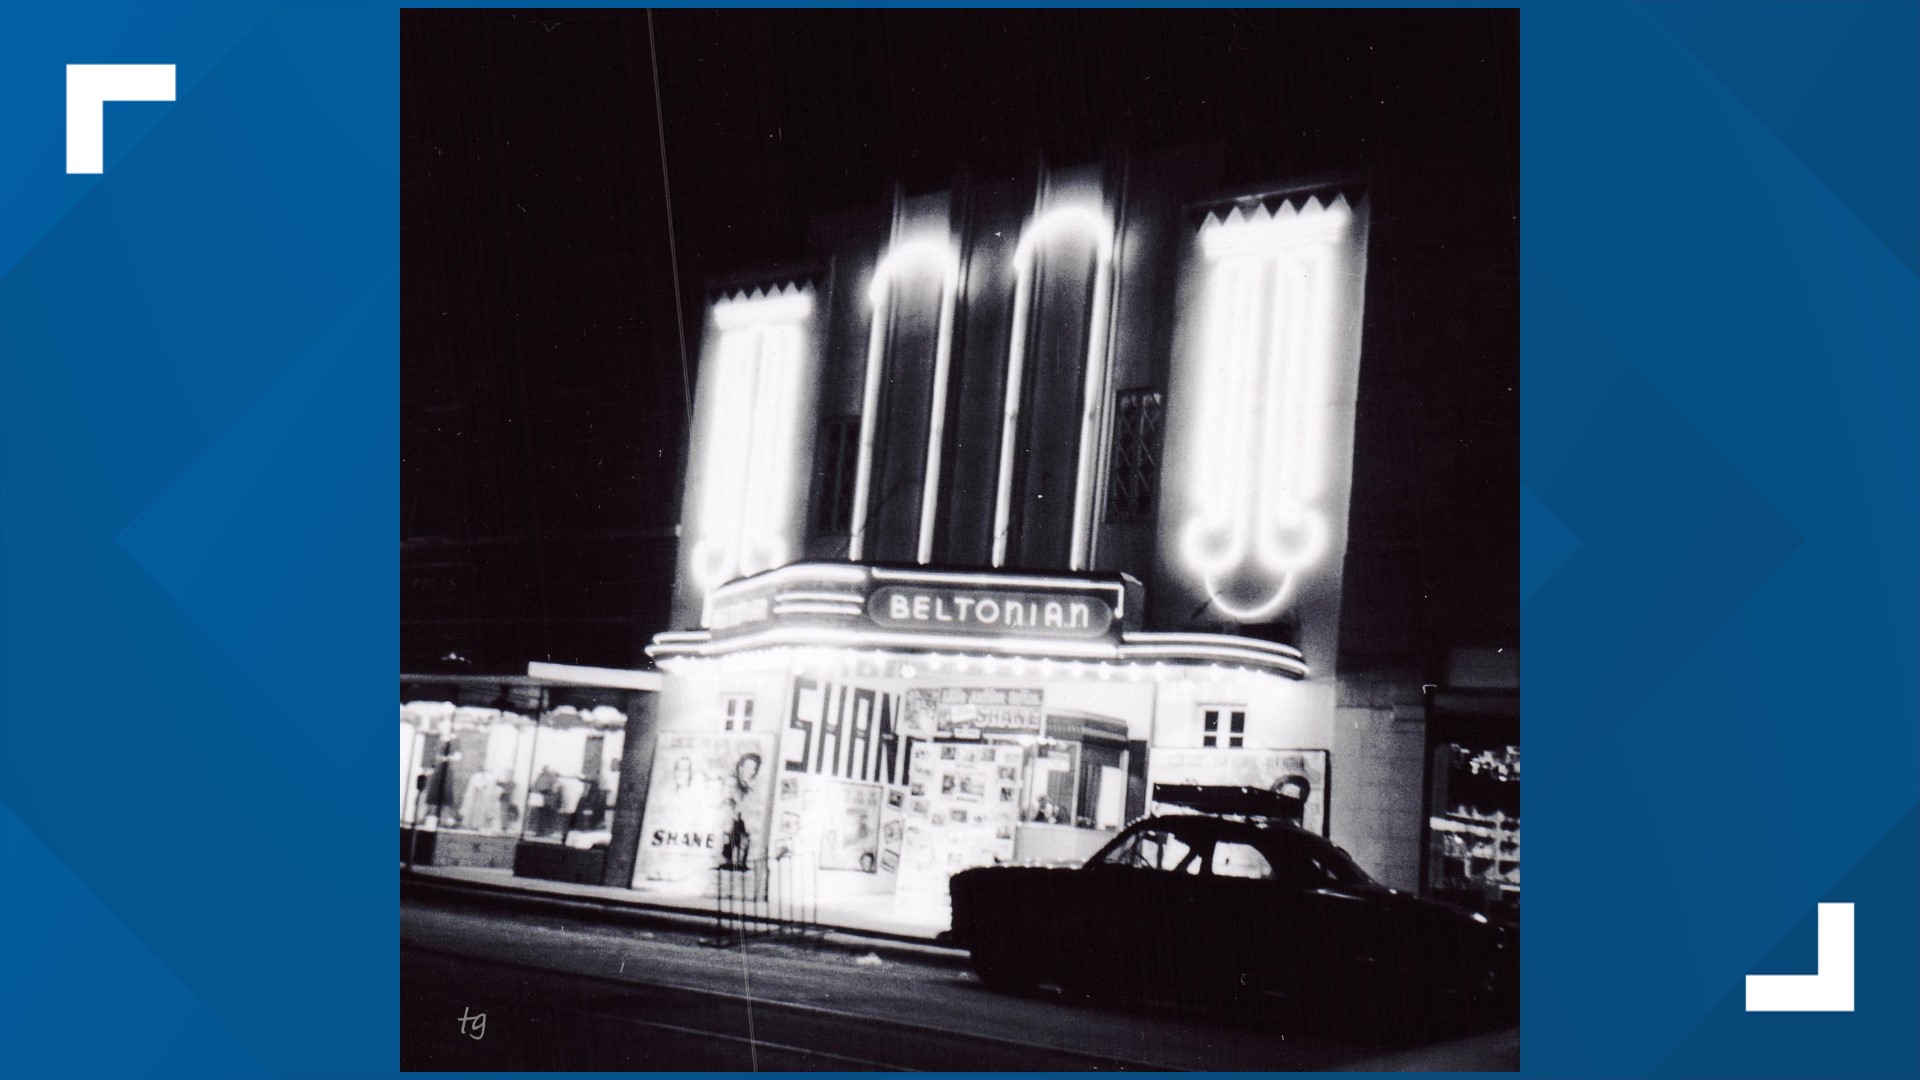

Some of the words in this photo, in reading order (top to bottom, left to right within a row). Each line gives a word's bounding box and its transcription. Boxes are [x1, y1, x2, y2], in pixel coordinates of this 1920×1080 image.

[890, 594, 1091, 629] BELTONIAN
[785, 677, 912, 787] SHAN
[974, 706, 1041, 729] SHANE
[651, 829, 715, 849] SHANE
